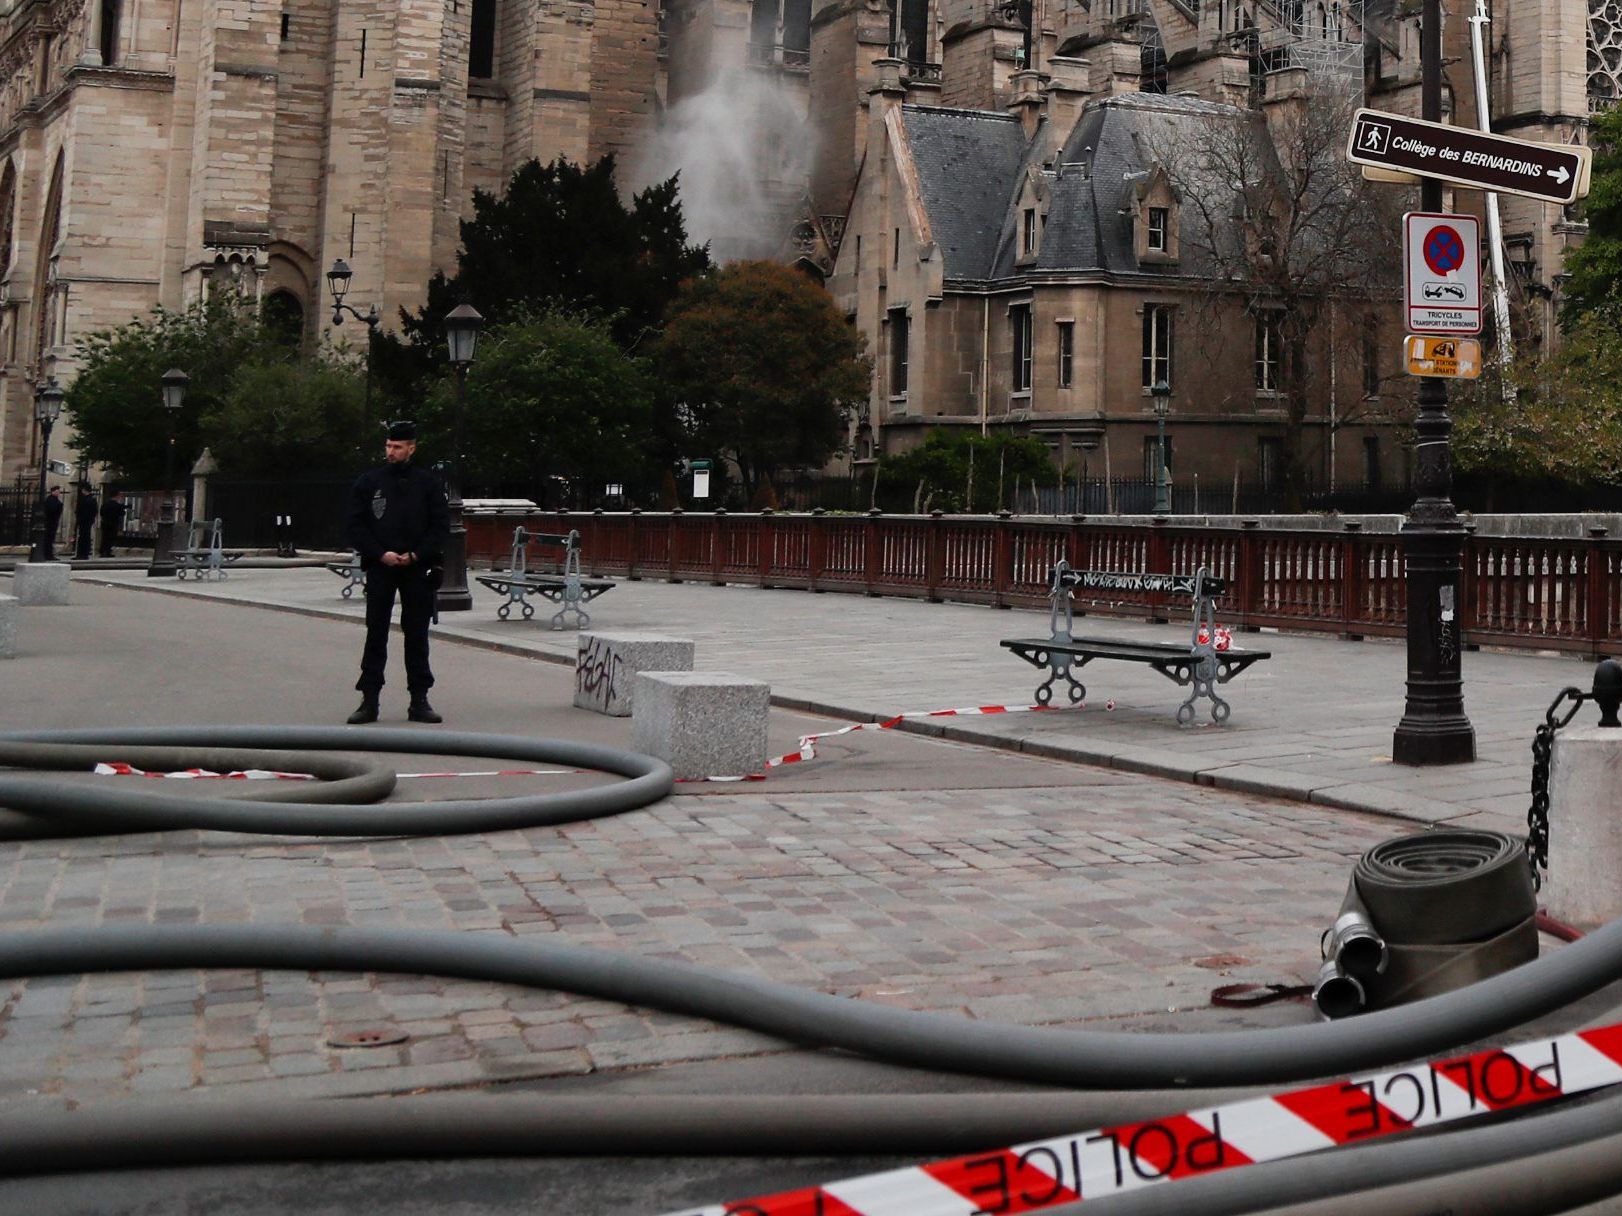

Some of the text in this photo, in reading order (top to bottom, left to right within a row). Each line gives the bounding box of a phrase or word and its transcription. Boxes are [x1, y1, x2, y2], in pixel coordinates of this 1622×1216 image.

[1392, 136, 1543, 177] Collège des BERNARDINS
[1427, 311, 1463, 320] TRICYCLES
[965, 1112, 1226, 1216] POLICE
[1340, 1042, 1563, 1138] POLICE
